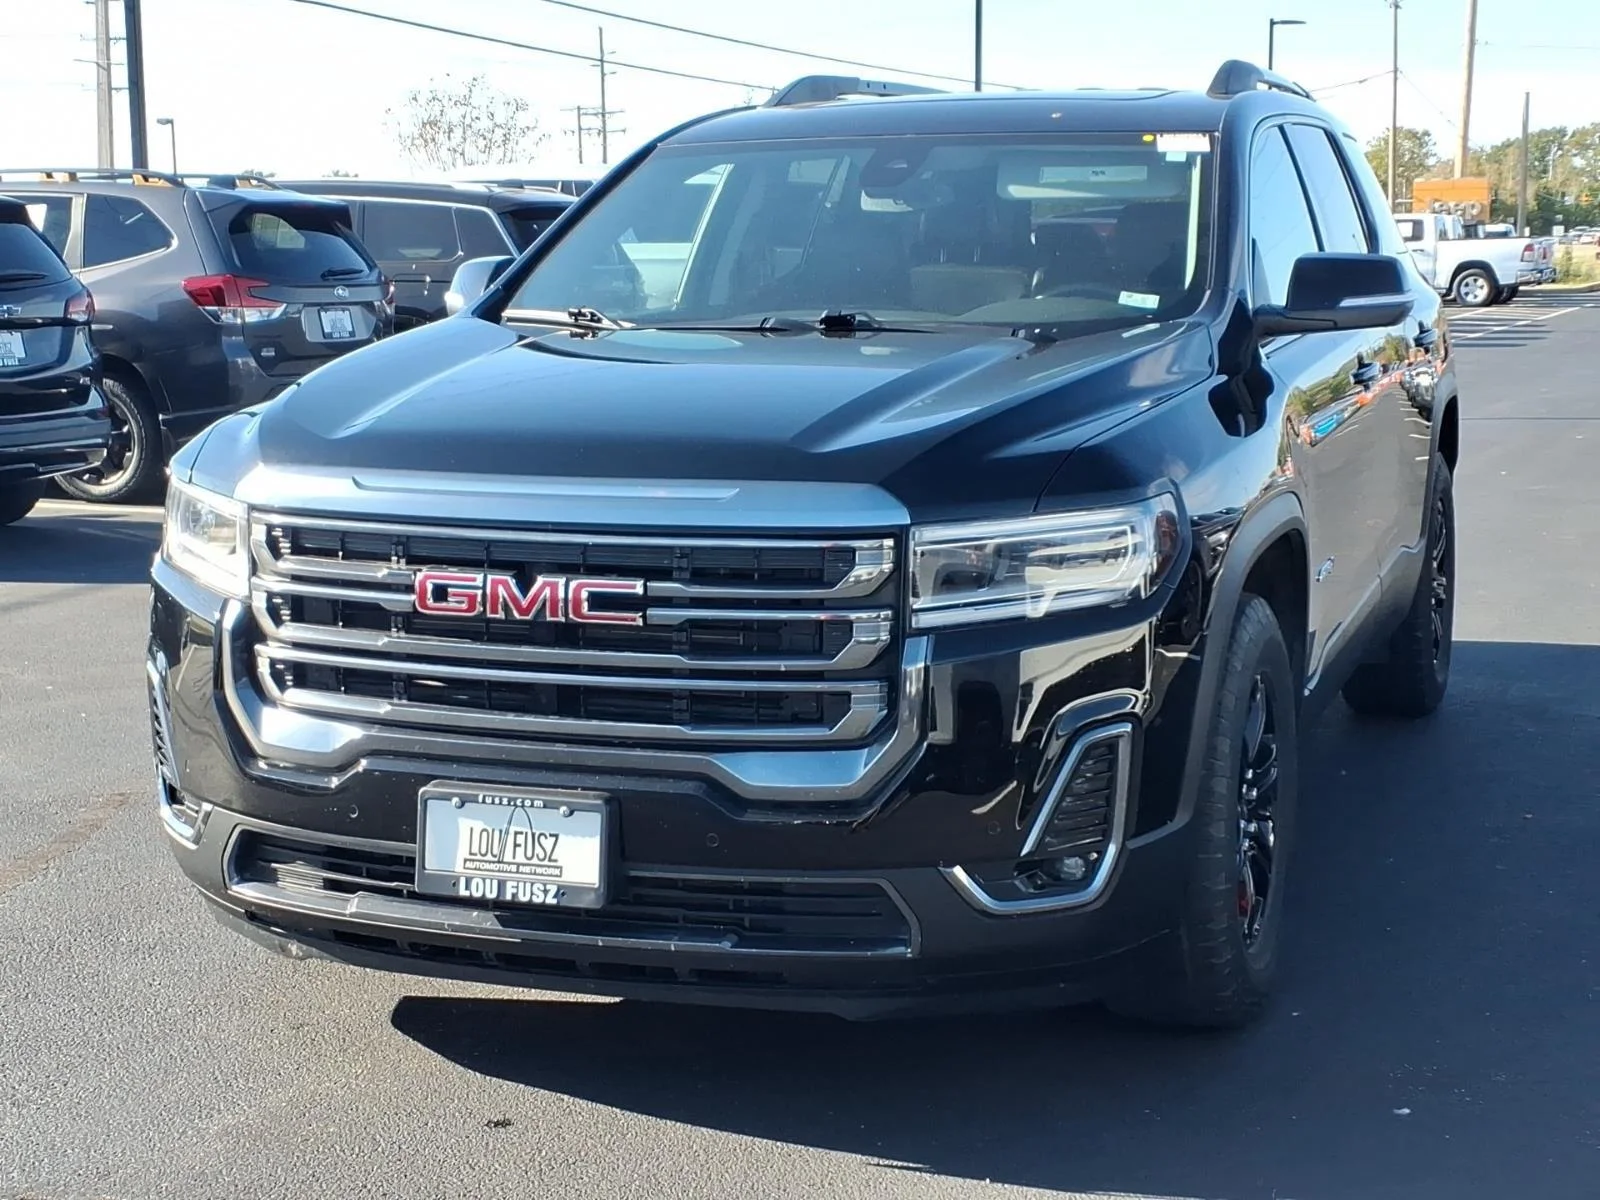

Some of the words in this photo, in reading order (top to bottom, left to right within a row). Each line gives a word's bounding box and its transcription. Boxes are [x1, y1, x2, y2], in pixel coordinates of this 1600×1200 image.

[414, 570, 645, 626] GMC
[478, 794, 544, 808] fusz.com
[468, 826, 503, 858] LOU
[512, 830, 560, 863] FUSZ
[465, 860, 517, 872] AUTOMOTIVE
[519, 865, 561, 876] NETWORK
[459, 876, 498, 899] LOU
[505, 881, 559, 905] FUSZ
